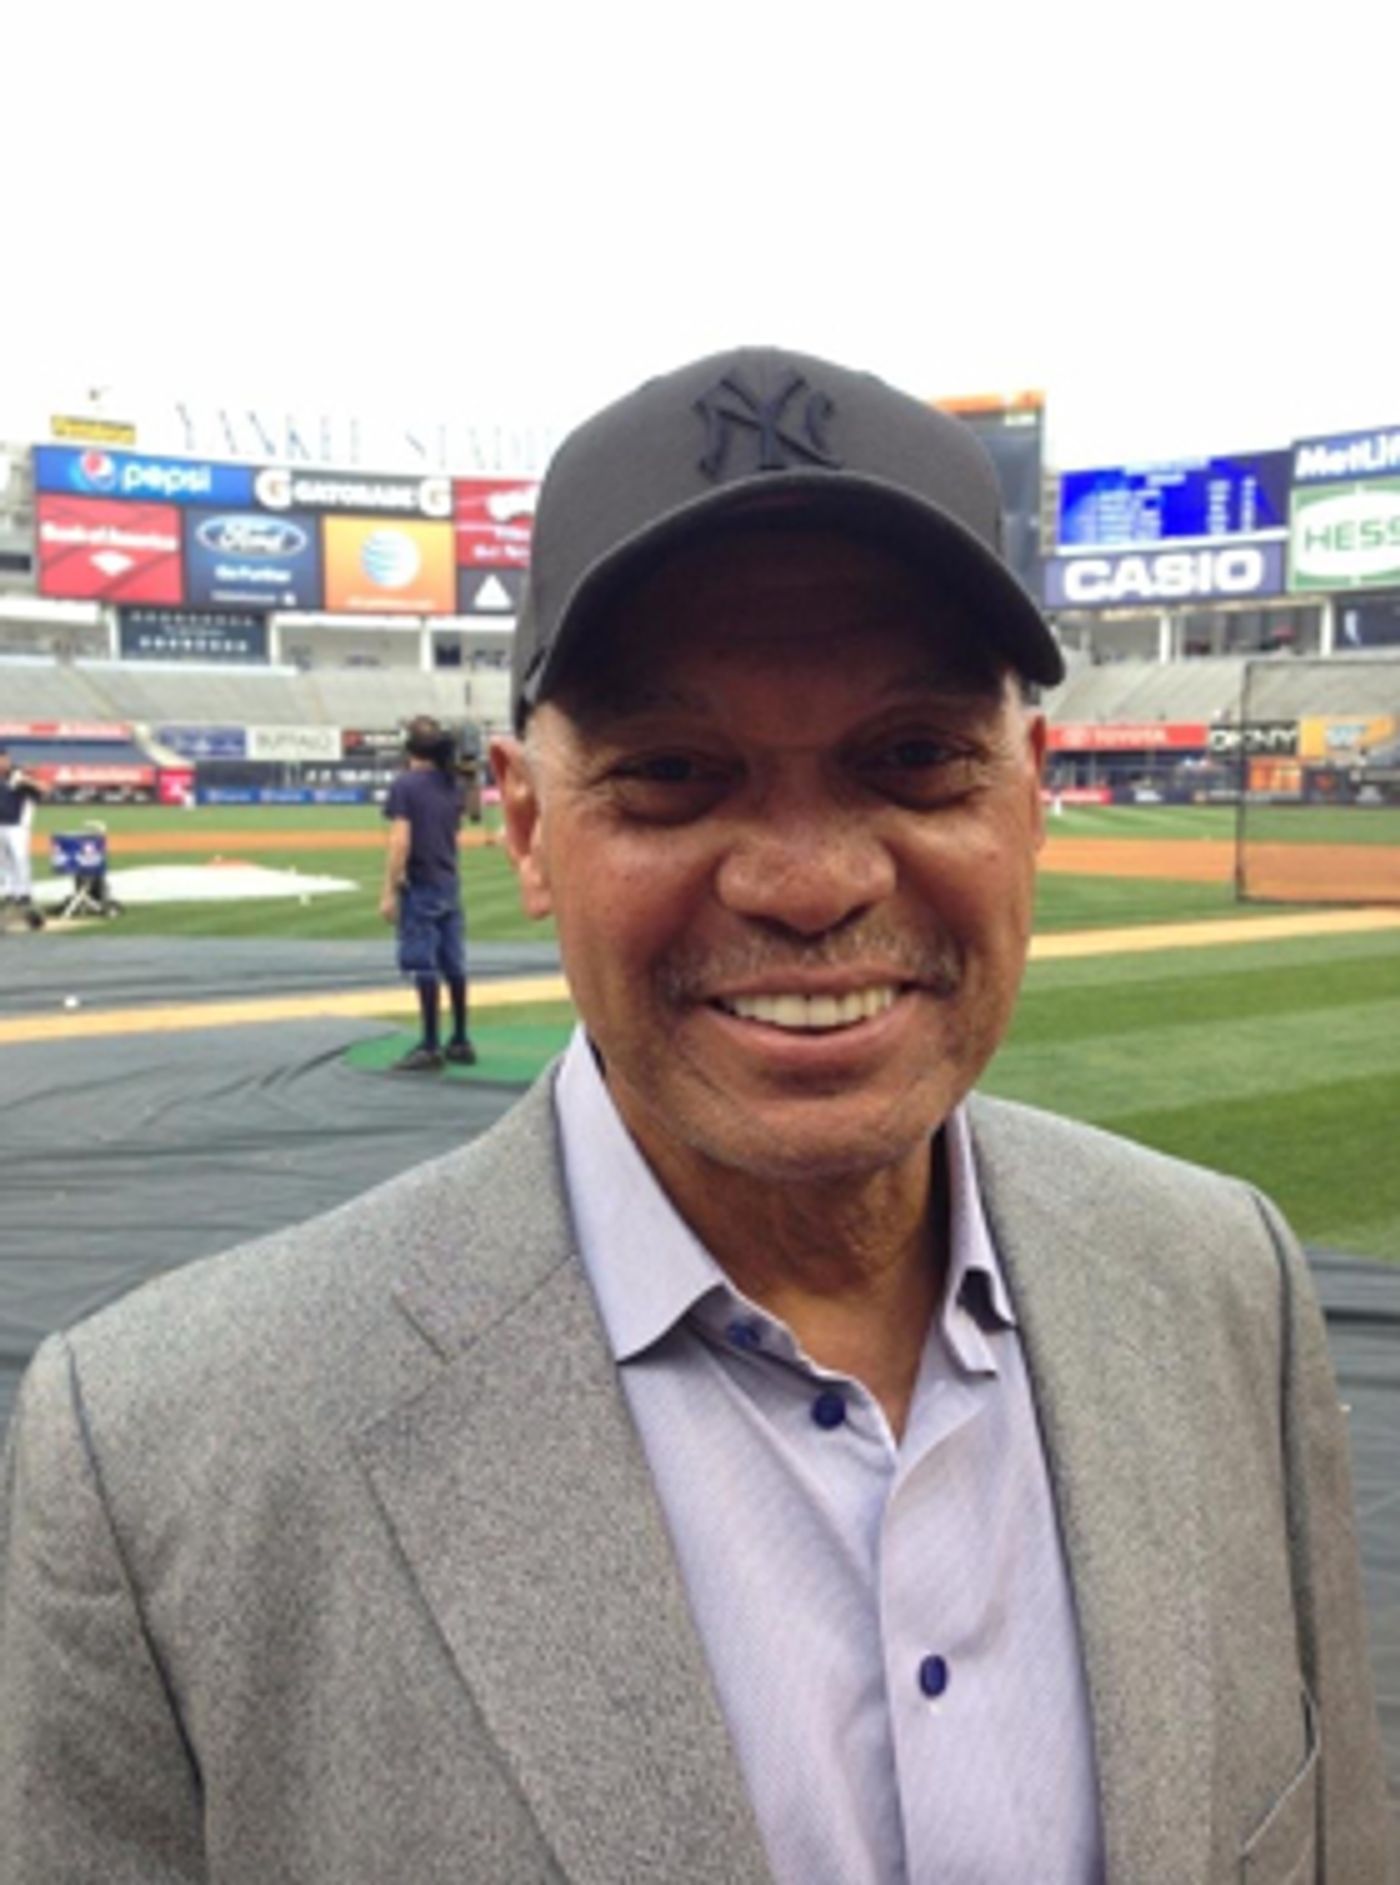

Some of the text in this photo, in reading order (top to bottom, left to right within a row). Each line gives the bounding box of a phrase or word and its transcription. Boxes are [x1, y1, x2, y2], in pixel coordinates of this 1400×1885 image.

[121, 463, 212, 497] pepsi
[294, 478, 419, 511] GATORADE
[219, 521, 284, 554] Ford
[1063, 548, 1264, 602] CASIO
